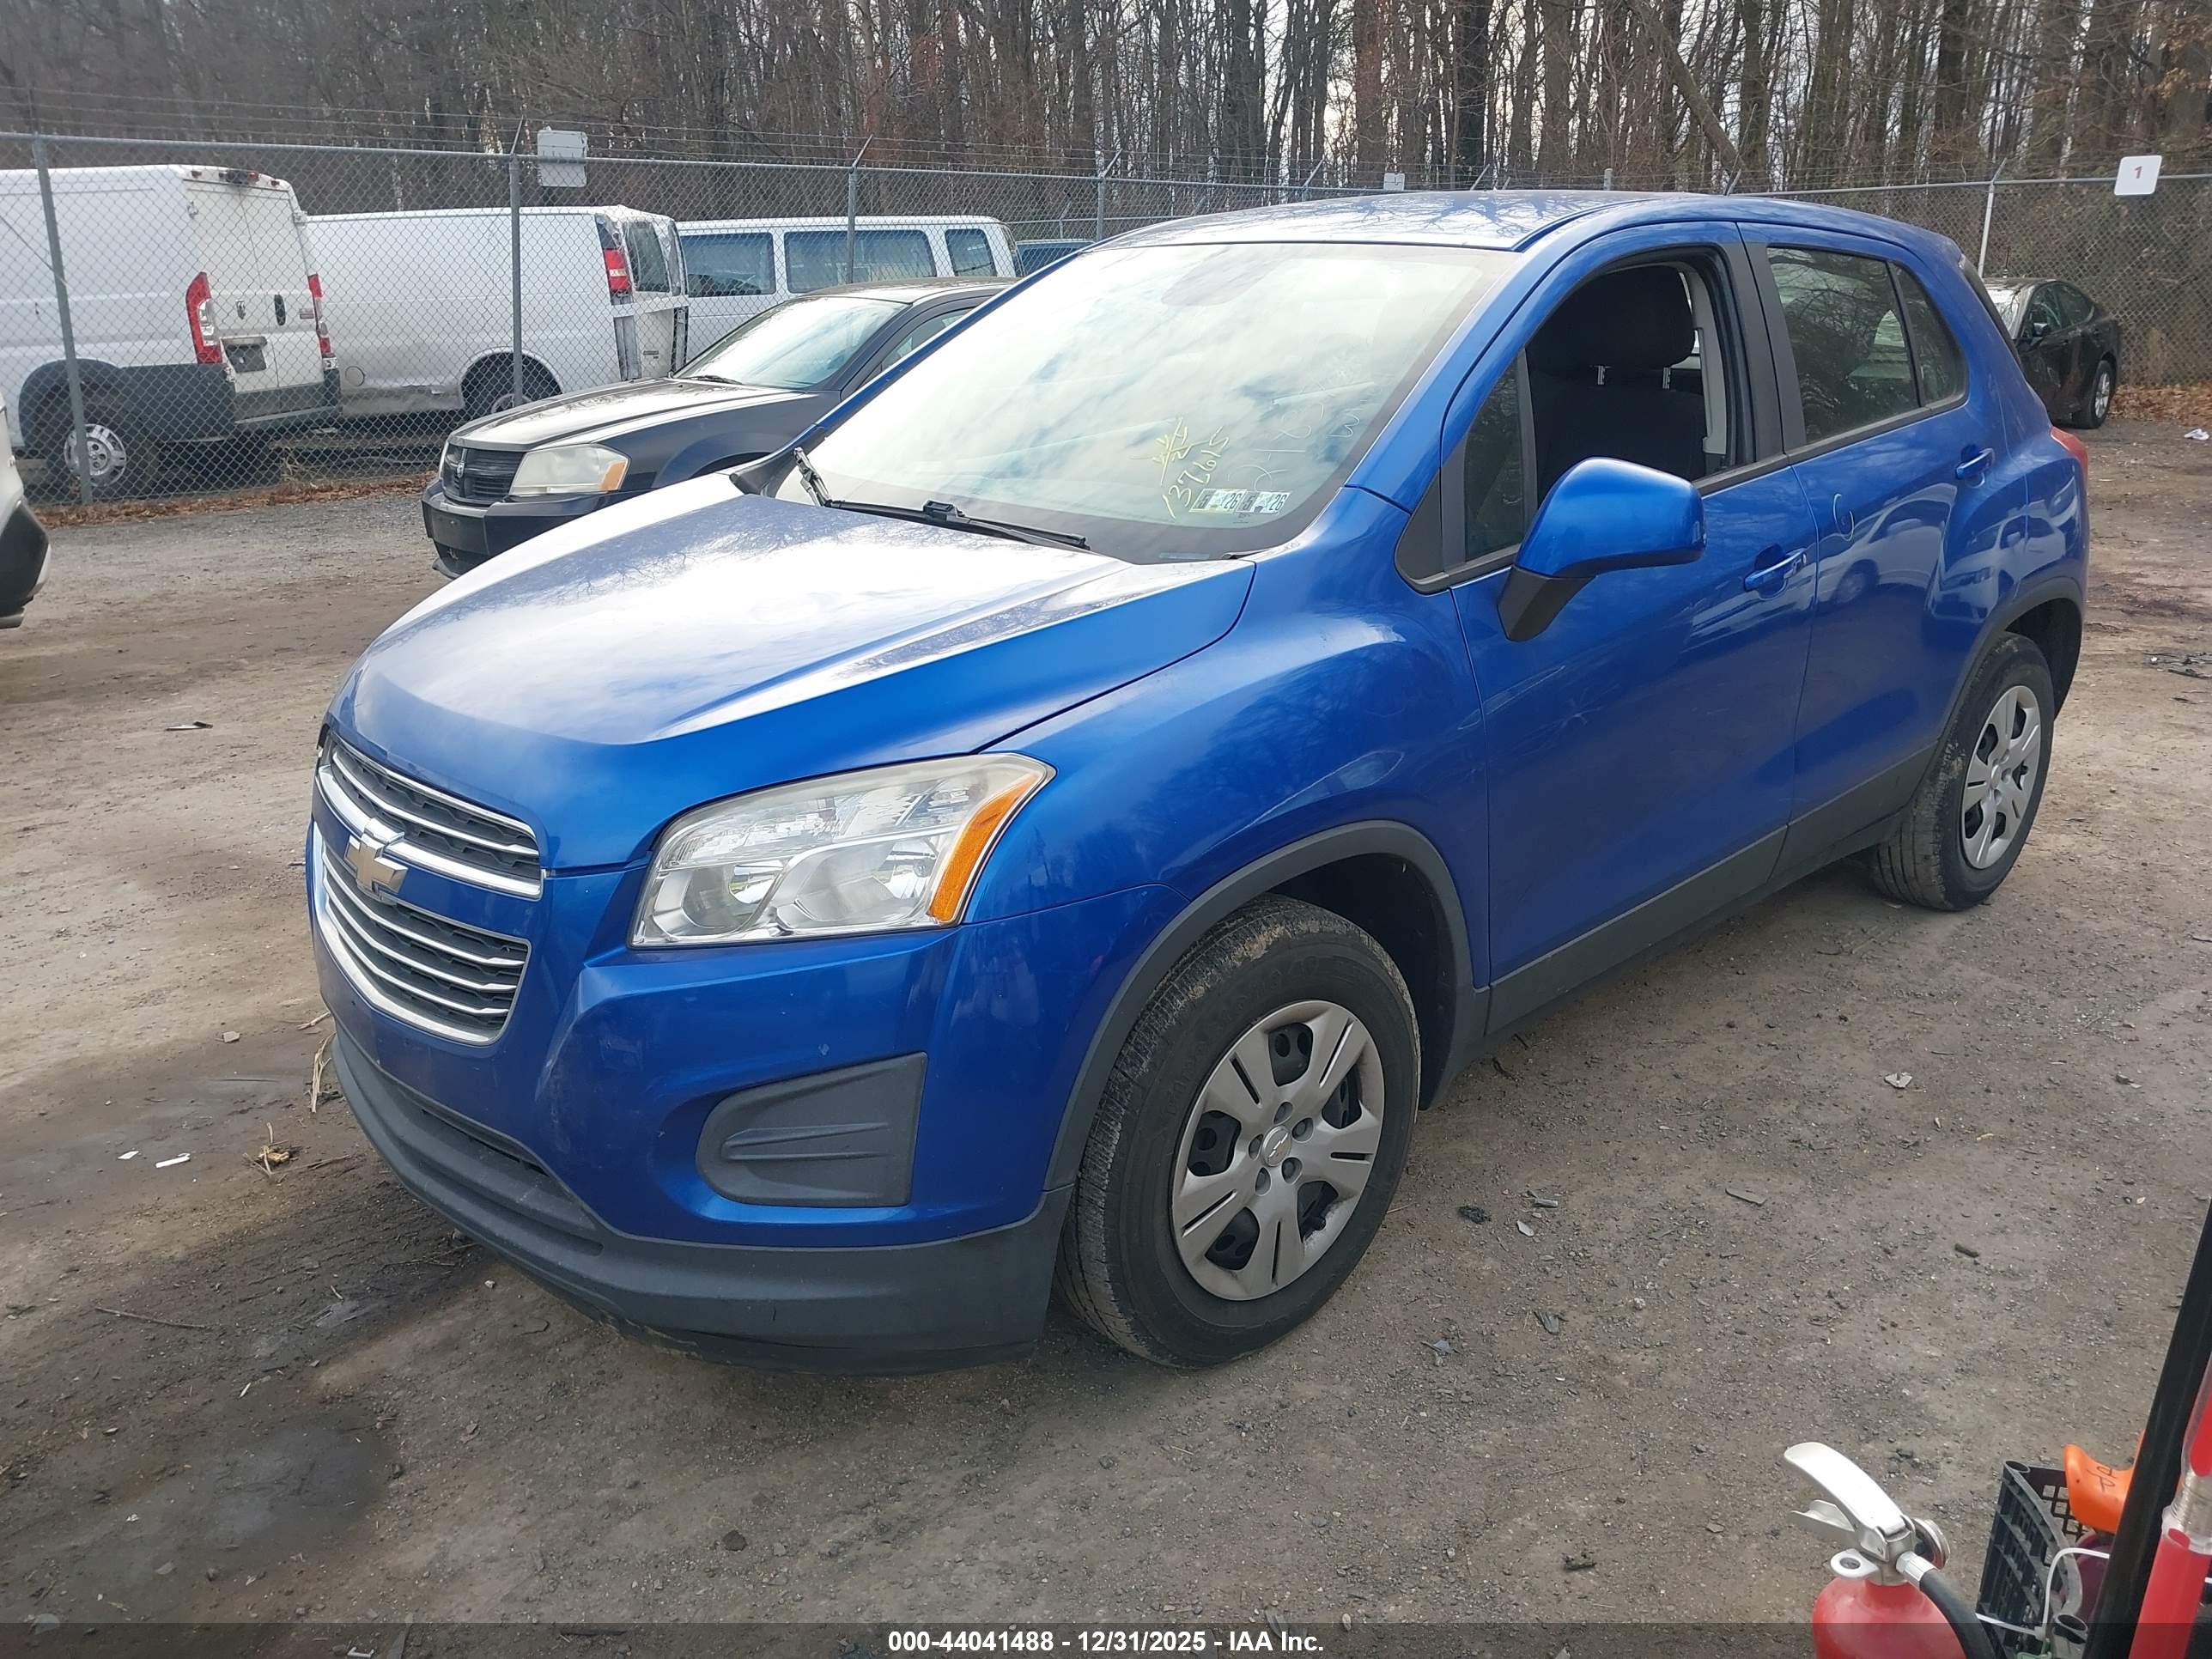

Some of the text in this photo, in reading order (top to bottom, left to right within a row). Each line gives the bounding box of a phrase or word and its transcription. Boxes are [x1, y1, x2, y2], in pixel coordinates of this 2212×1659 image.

[2134, 166, 2142, 179] 1
[1223, 493, 1243, 509] 26
[1243, 494, 1287, 511] 5 26
